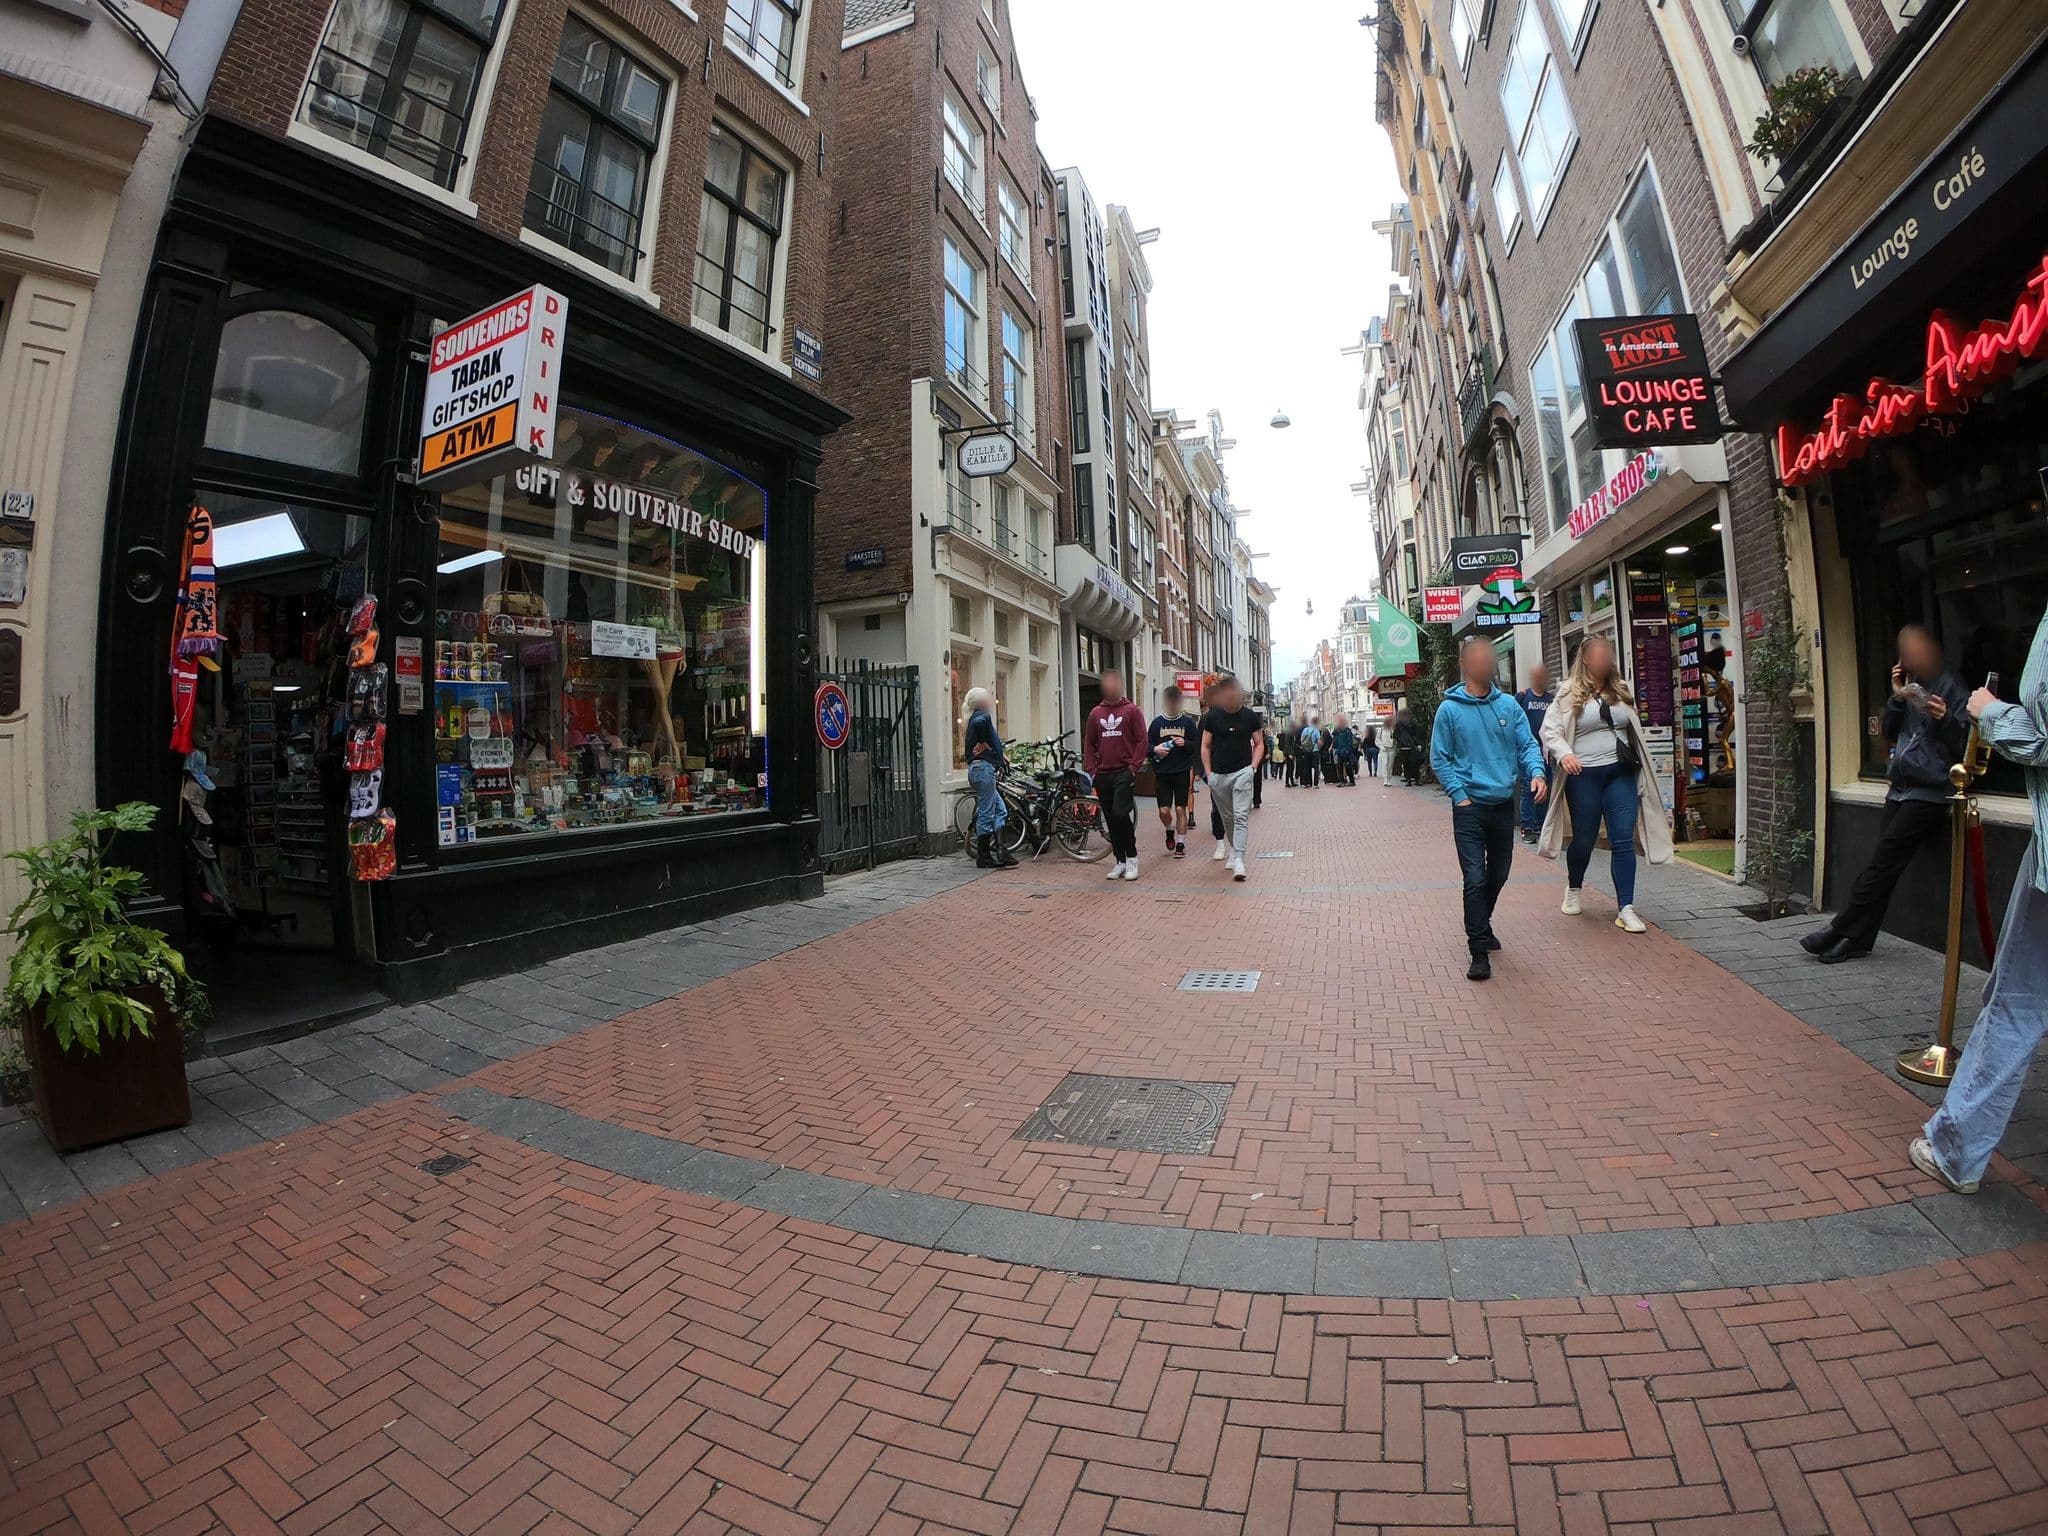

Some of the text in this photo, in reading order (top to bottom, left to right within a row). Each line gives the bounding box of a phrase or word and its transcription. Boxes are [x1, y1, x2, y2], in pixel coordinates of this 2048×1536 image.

[1850, 146, 1986, 290] Lounge Café
[434, 299, 530, 366] SOUVENIRS
[1602, 324, 1681, 369] LOST
[1605, 340, 1679, 352] In Amsterdam
[451, 347, 504, 394] TABAK
[529, 295, 559, 448] DRINK
[1600, 377, 1707, 406] LOUNGE
[432, 374, 515, 428] GIFTSHOP
[1624, 406, 1697, 433] CAFE
[440, 415, 497, 463] ATM
[969, 444, 1006, 457] DILLE &
[1778, 398, 1848, 480] Lost
[1858, 381, 1916, 436] in
[966, 453, 1009, 466] KAMILLE
[515, 464, 756, 560] GIFT & SOUVENIR SHOP
[1567, 453, 1646, 540] SMART SHOP
[1460, 553, 1515, 566] CIAO PAPA
[1427, 603, 1460, 611] LIQUOR
[1476, 614, 1491, 625] SEED
